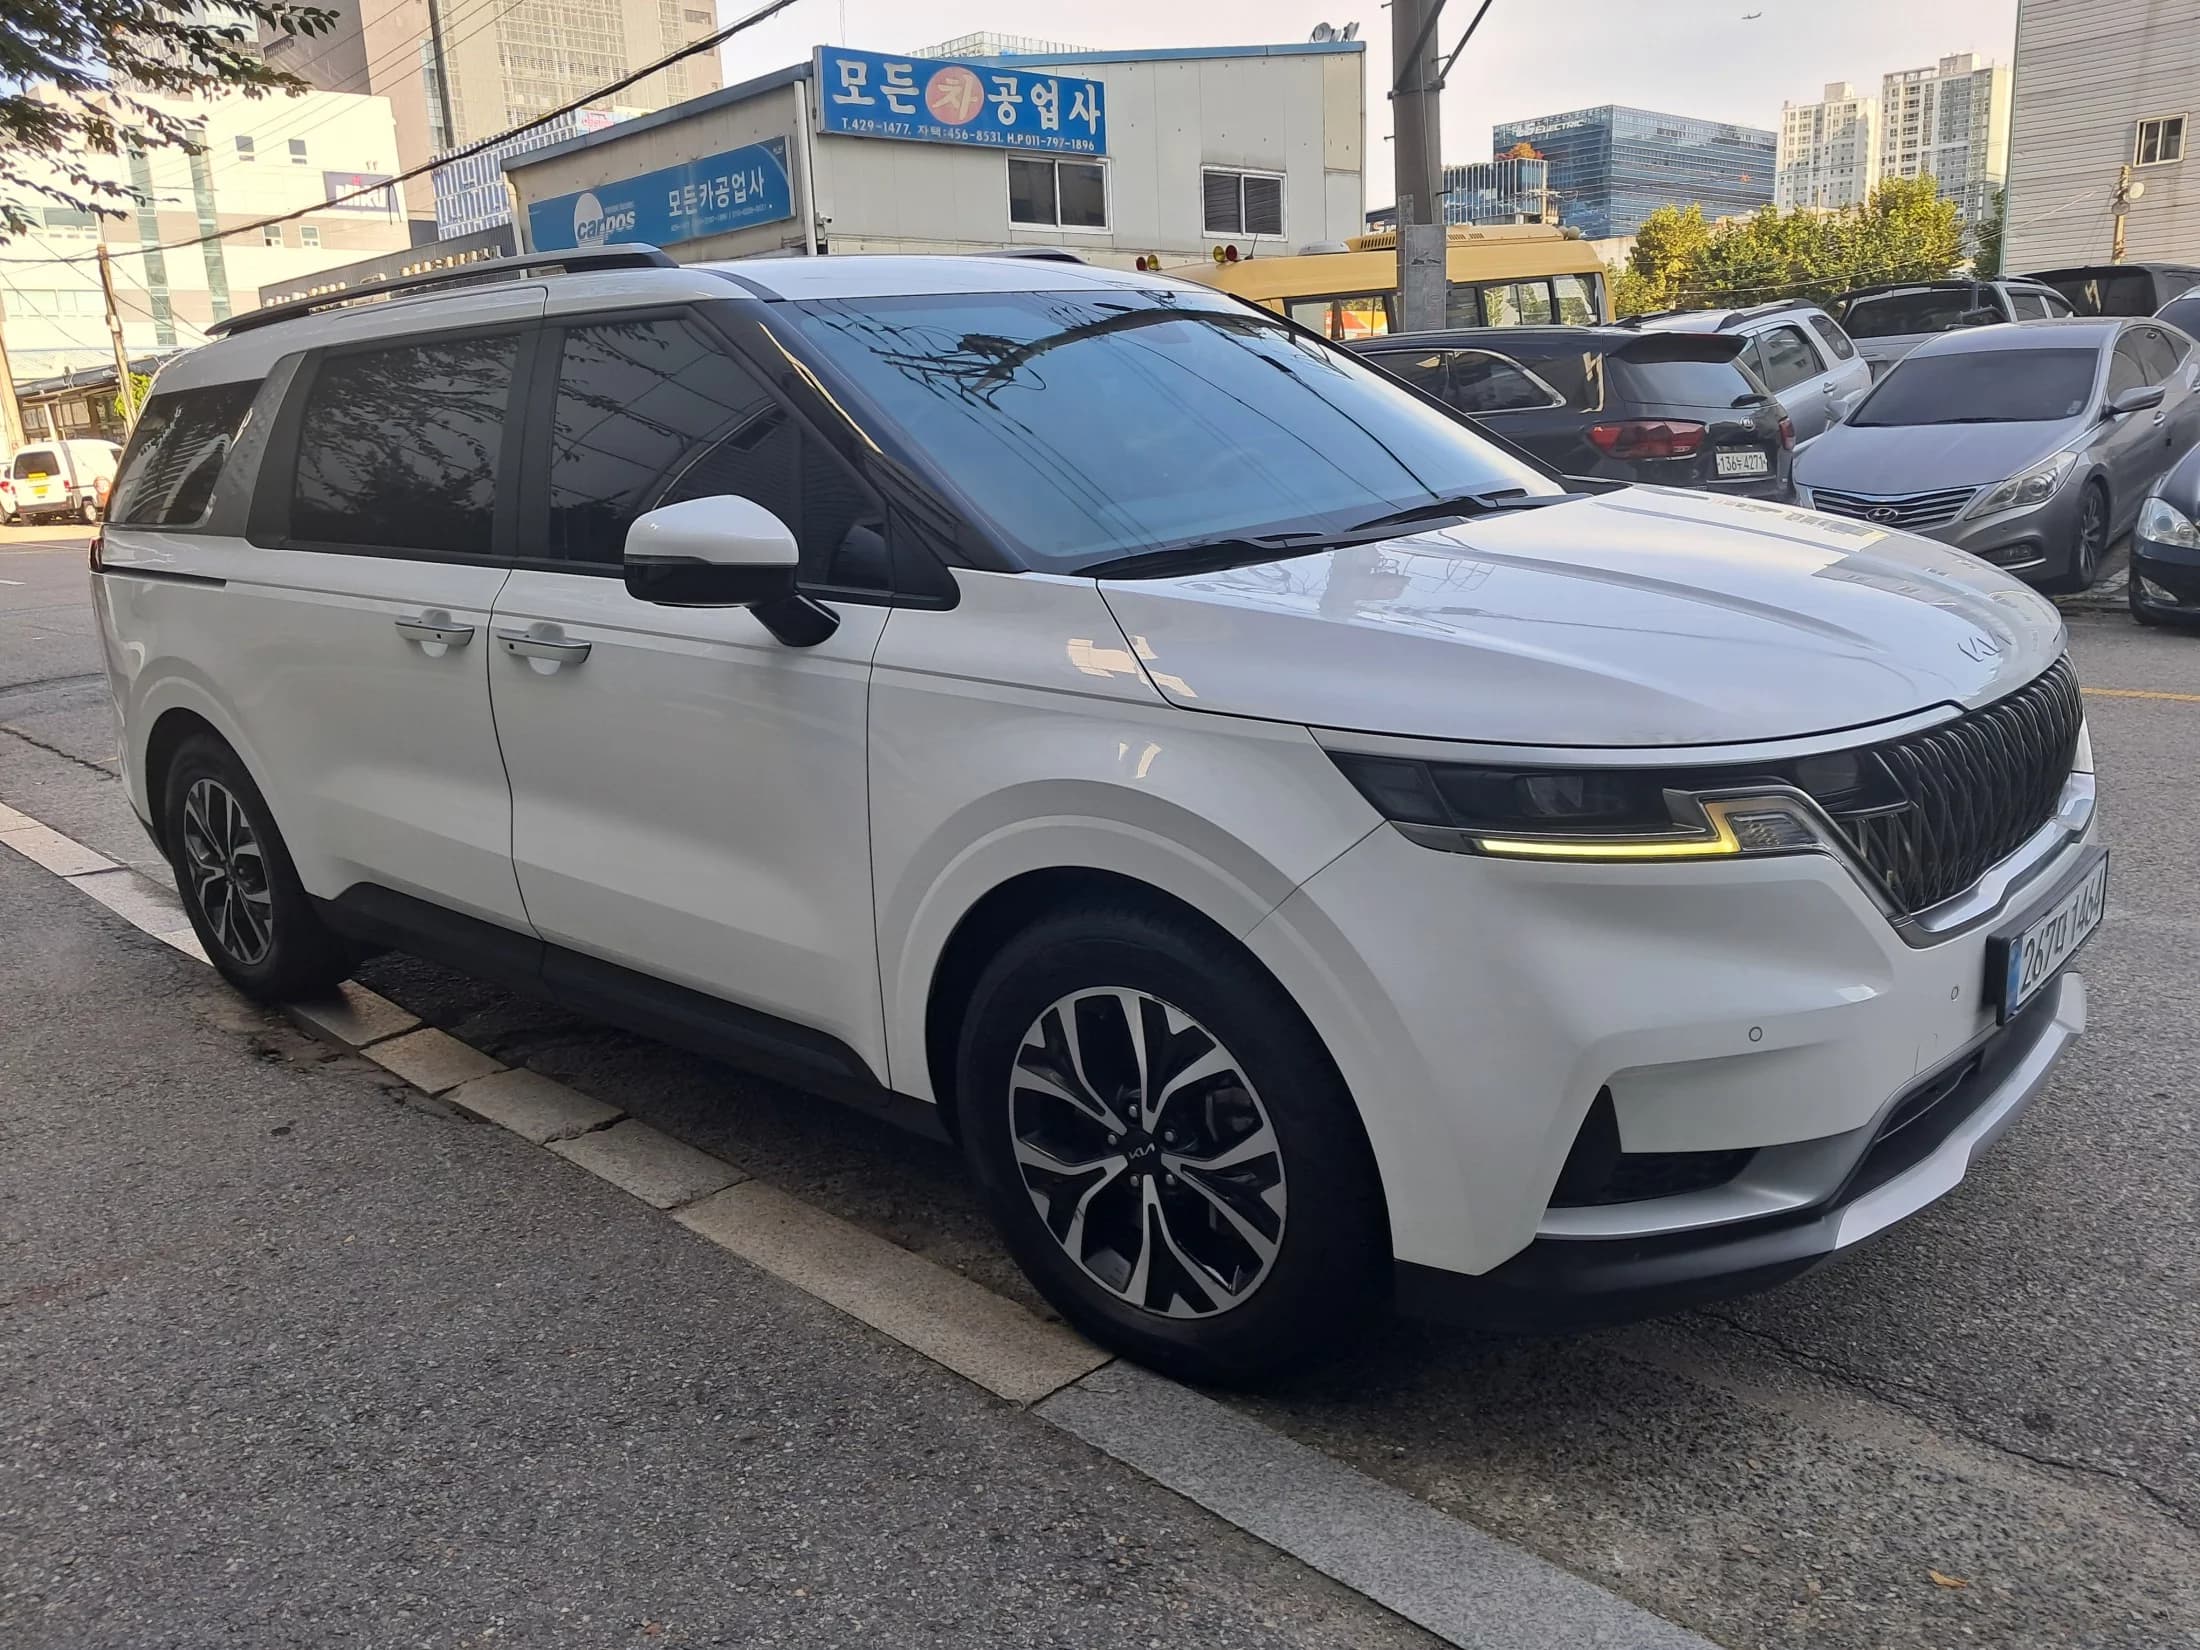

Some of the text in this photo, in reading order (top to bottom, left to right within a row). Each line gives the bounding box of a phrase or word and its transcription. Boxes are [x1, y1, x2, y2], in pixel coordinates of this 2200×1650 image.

[668, 165, 765, 218] 모든카공업사
[1744, 454, 1764, 470] 4271
[2070, 867, 2104, 943] 1464
